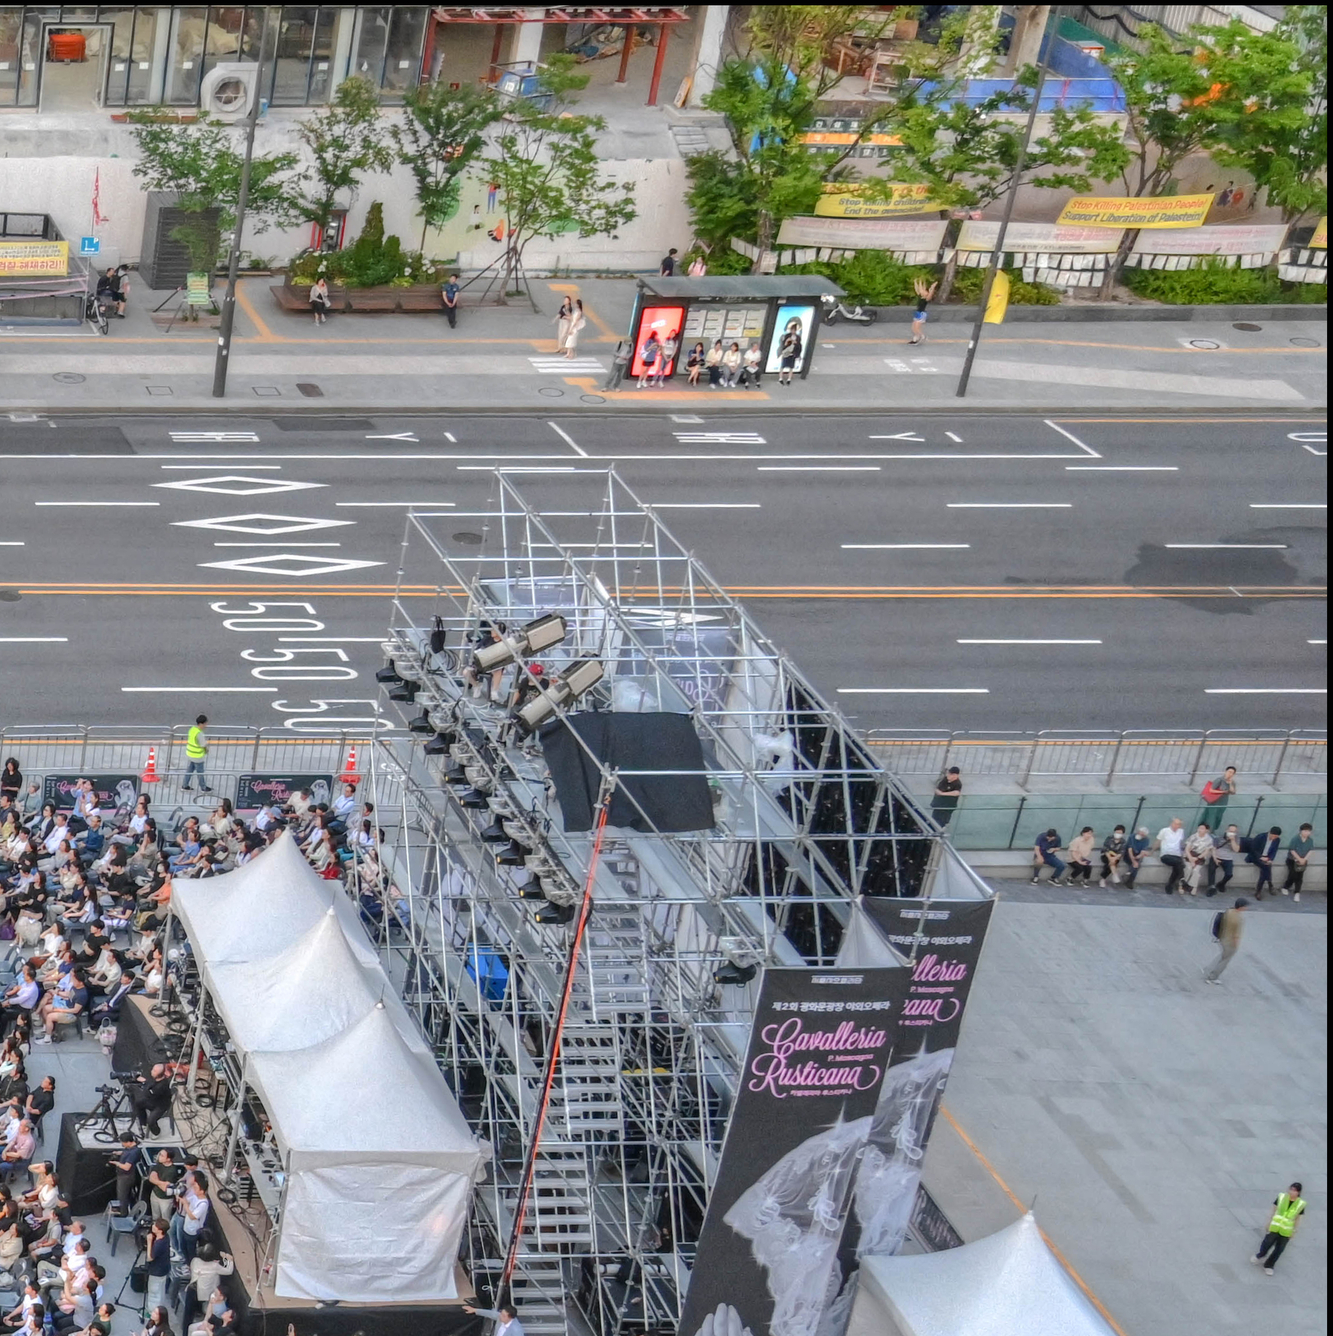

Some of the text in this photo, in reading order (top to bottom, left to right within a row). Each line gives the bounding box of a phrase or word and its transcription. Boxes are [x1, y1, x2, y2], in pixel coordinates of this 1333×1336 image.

[843, 207, 861, 215] End
[1071, 199, 1208, 211] Stop Killing Palestinian People!
[1062, 211, 1100, 222] Support
[1100, 212, 1146, 223] Liberation
[1146, 213, 1159, 222] of
[208, 601, 326, 632] 50
[240, 648, 359, 681] 50
[771, 1001, 799, 1012] 제2회
[799, 1001, 845, 1013] 광화문광장
[846, 1000, 890, 1012] 야외오페라
[761, 1017, 887, 1060] Cavalleria
[748, 1052, 881, 1098] Rusticana
